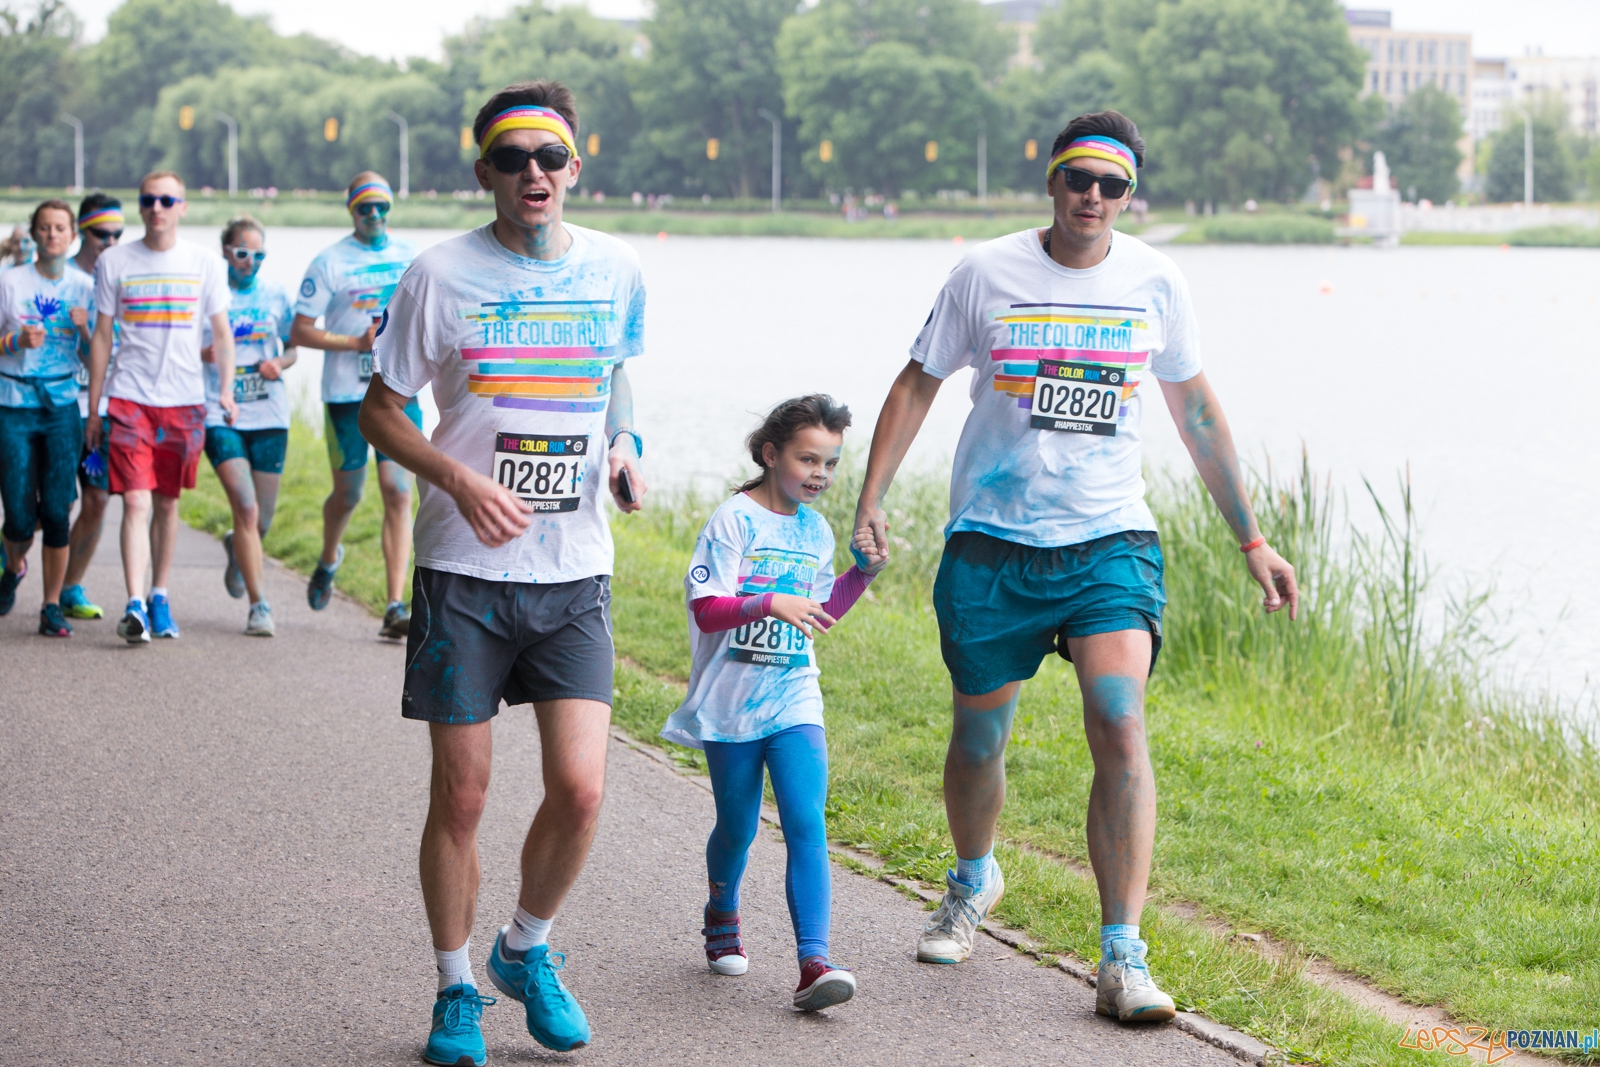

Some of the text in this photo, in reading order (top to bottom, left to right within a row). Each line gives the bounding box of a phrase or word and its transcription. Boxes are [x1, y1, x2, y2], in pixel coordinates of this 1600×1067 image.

[482, 321, 608, 346] THE COLOR RUN
[1008, 323, 1132, 350] THE COLOR RUN
[1044, 365, 1100, 380] THE COLOR RUN
[234, 376, 265, 392] 2032
[1038, 383, 1117, 420] 02820
[1055, 421, 1093, 431] #HAPPIEST5K
[503, 438, 566, 453] THE COLOR RUN
[498, 458, 579, 495] 02821
[521, 500, 561, 511] HAPPIEST5K
[751, 560, 768, 576] THE
[735, 619, 805, 651] 02819
[752, 653, 790, 664] #HAPPIEST5K
